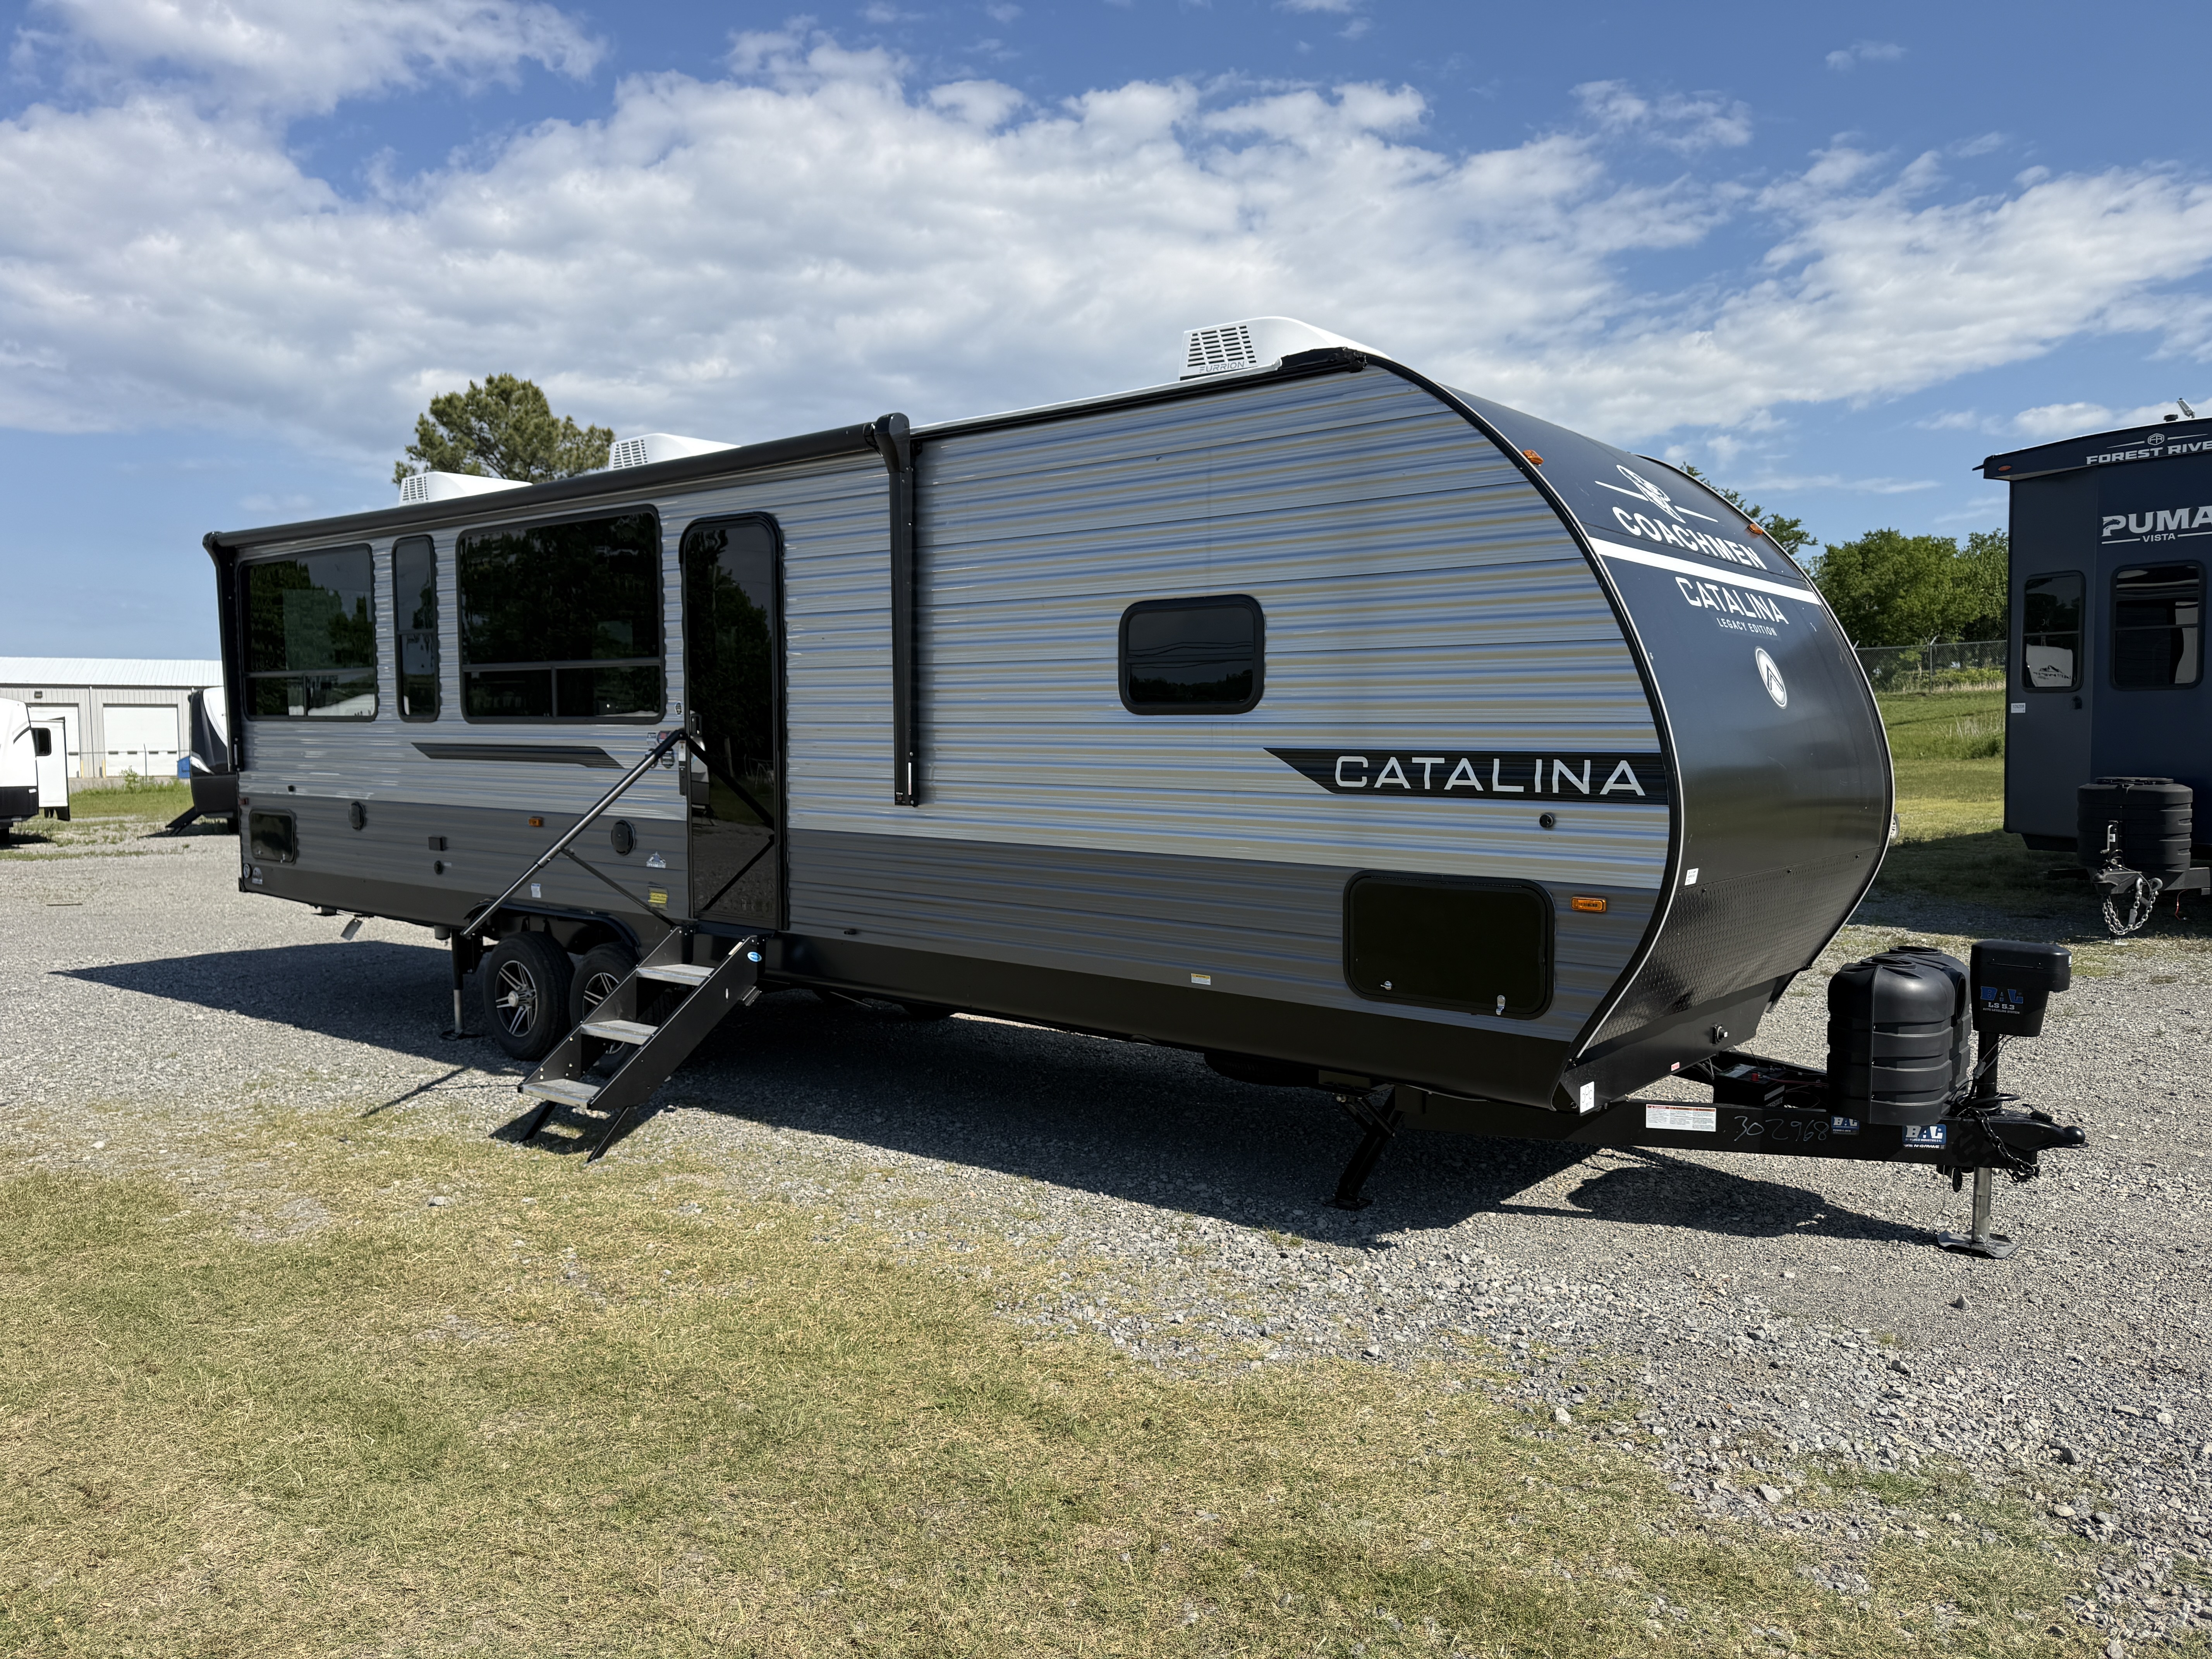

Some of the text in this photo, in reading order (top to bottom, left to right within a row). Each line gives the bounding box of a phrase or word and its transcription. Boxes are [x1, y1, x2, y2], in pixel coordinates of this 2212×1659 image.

[1199, 361, 1244, 373] FURRION
[2086, 447, 2163, 465] FOREST
[2101, 505, 2212, 536] PUMA
[1612, 507, 1767, 570] COACHMEN
[2142, 533, 2176, 542] VISTA
[1675, 576, 1789, 625] CATALINA
[1716, 618, 1777, 636] LEGACY EDITION
[1335, 756, 1646, 796] CATALINA
[1980, 986, 2024, 1004] BAL
[1906, 1125, 1943, 1139] BAL
